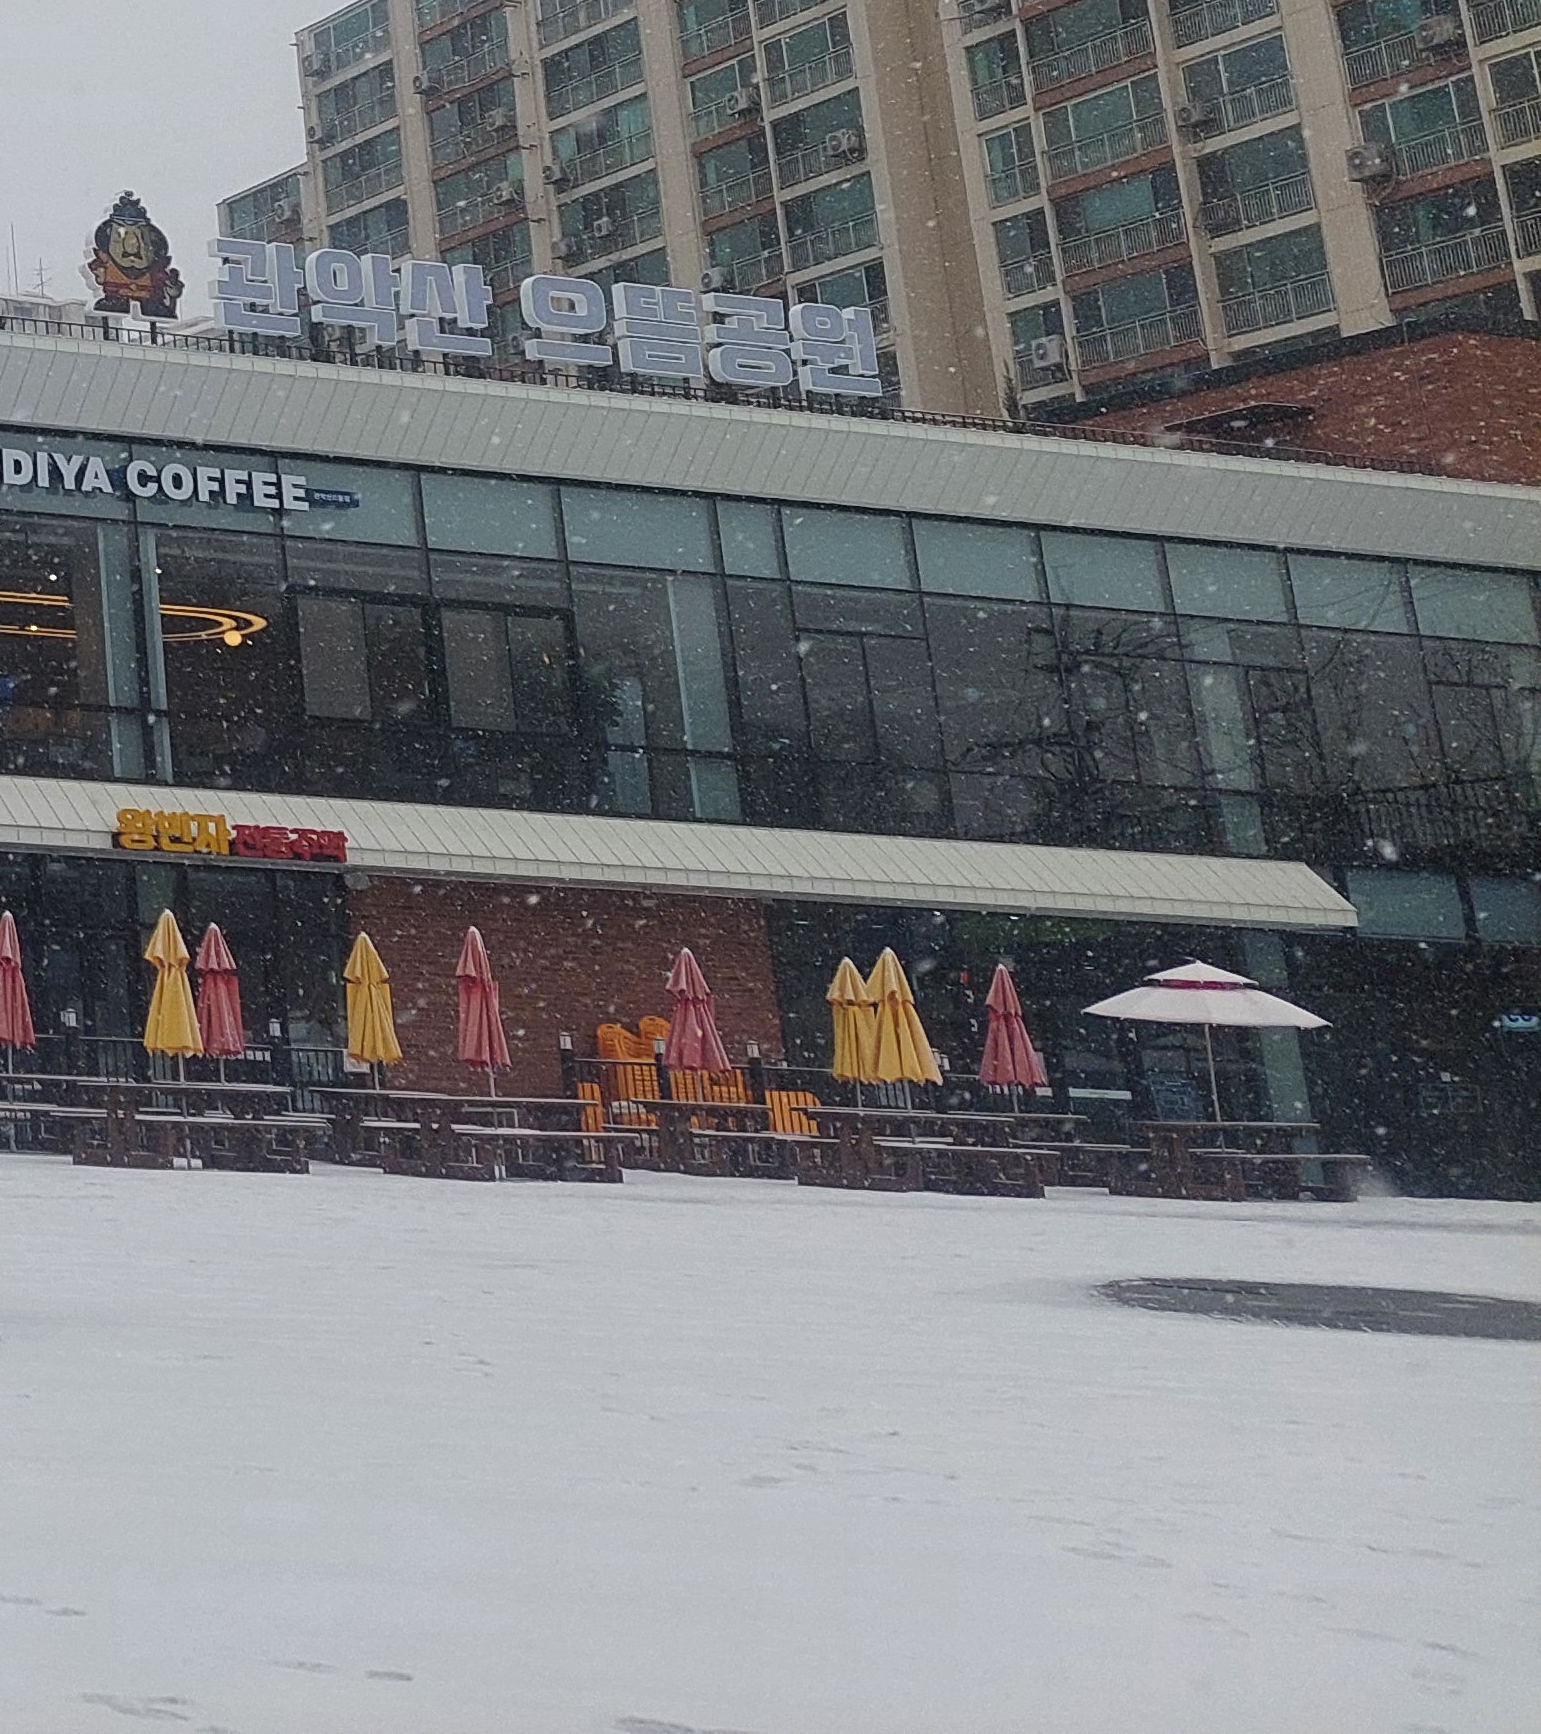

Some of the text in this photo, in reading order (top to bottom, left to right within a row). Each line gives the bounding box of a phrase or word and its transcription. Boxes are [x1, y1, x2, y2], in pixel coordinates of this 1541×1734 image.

[208, 236, 883, 398] 관악산 으뜸공원
[126, 459, 310, 511] COFFEE
[117, 808, 231, 856] 왕빈자
